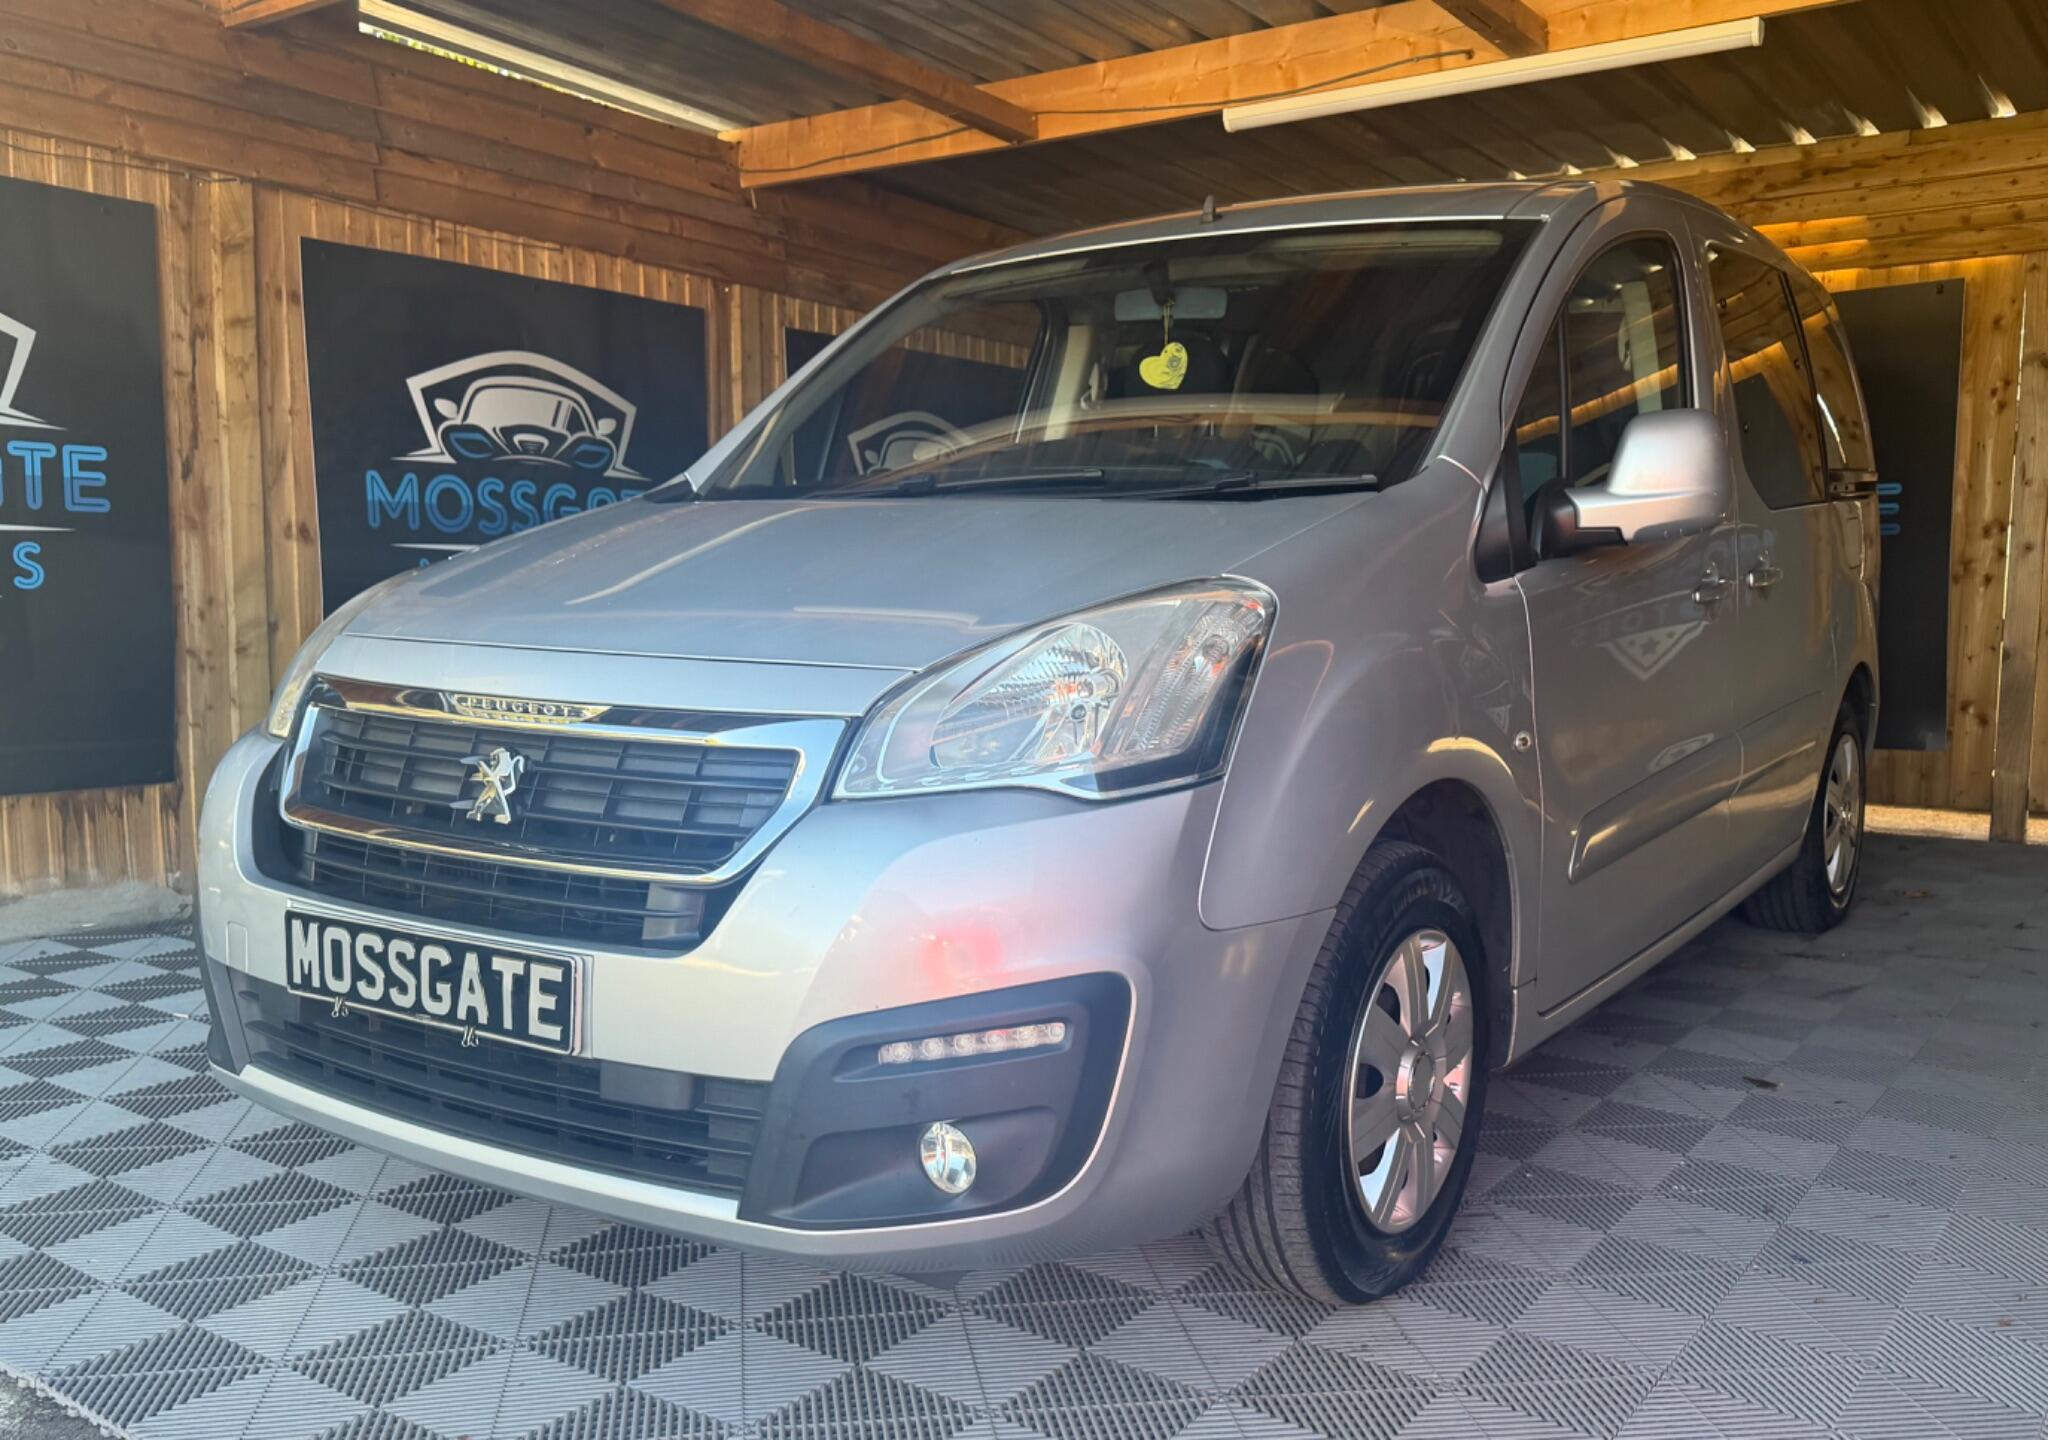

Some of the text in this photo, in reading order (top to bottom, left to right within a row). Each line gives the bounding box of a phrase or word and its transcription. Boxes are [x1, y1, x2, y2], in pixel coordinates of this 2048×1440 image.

[0, 440, 111, 513] TE
[466, 697, 574, 718] PEUGEOT
[291, 918, 566, 1041] MOSSGATE
